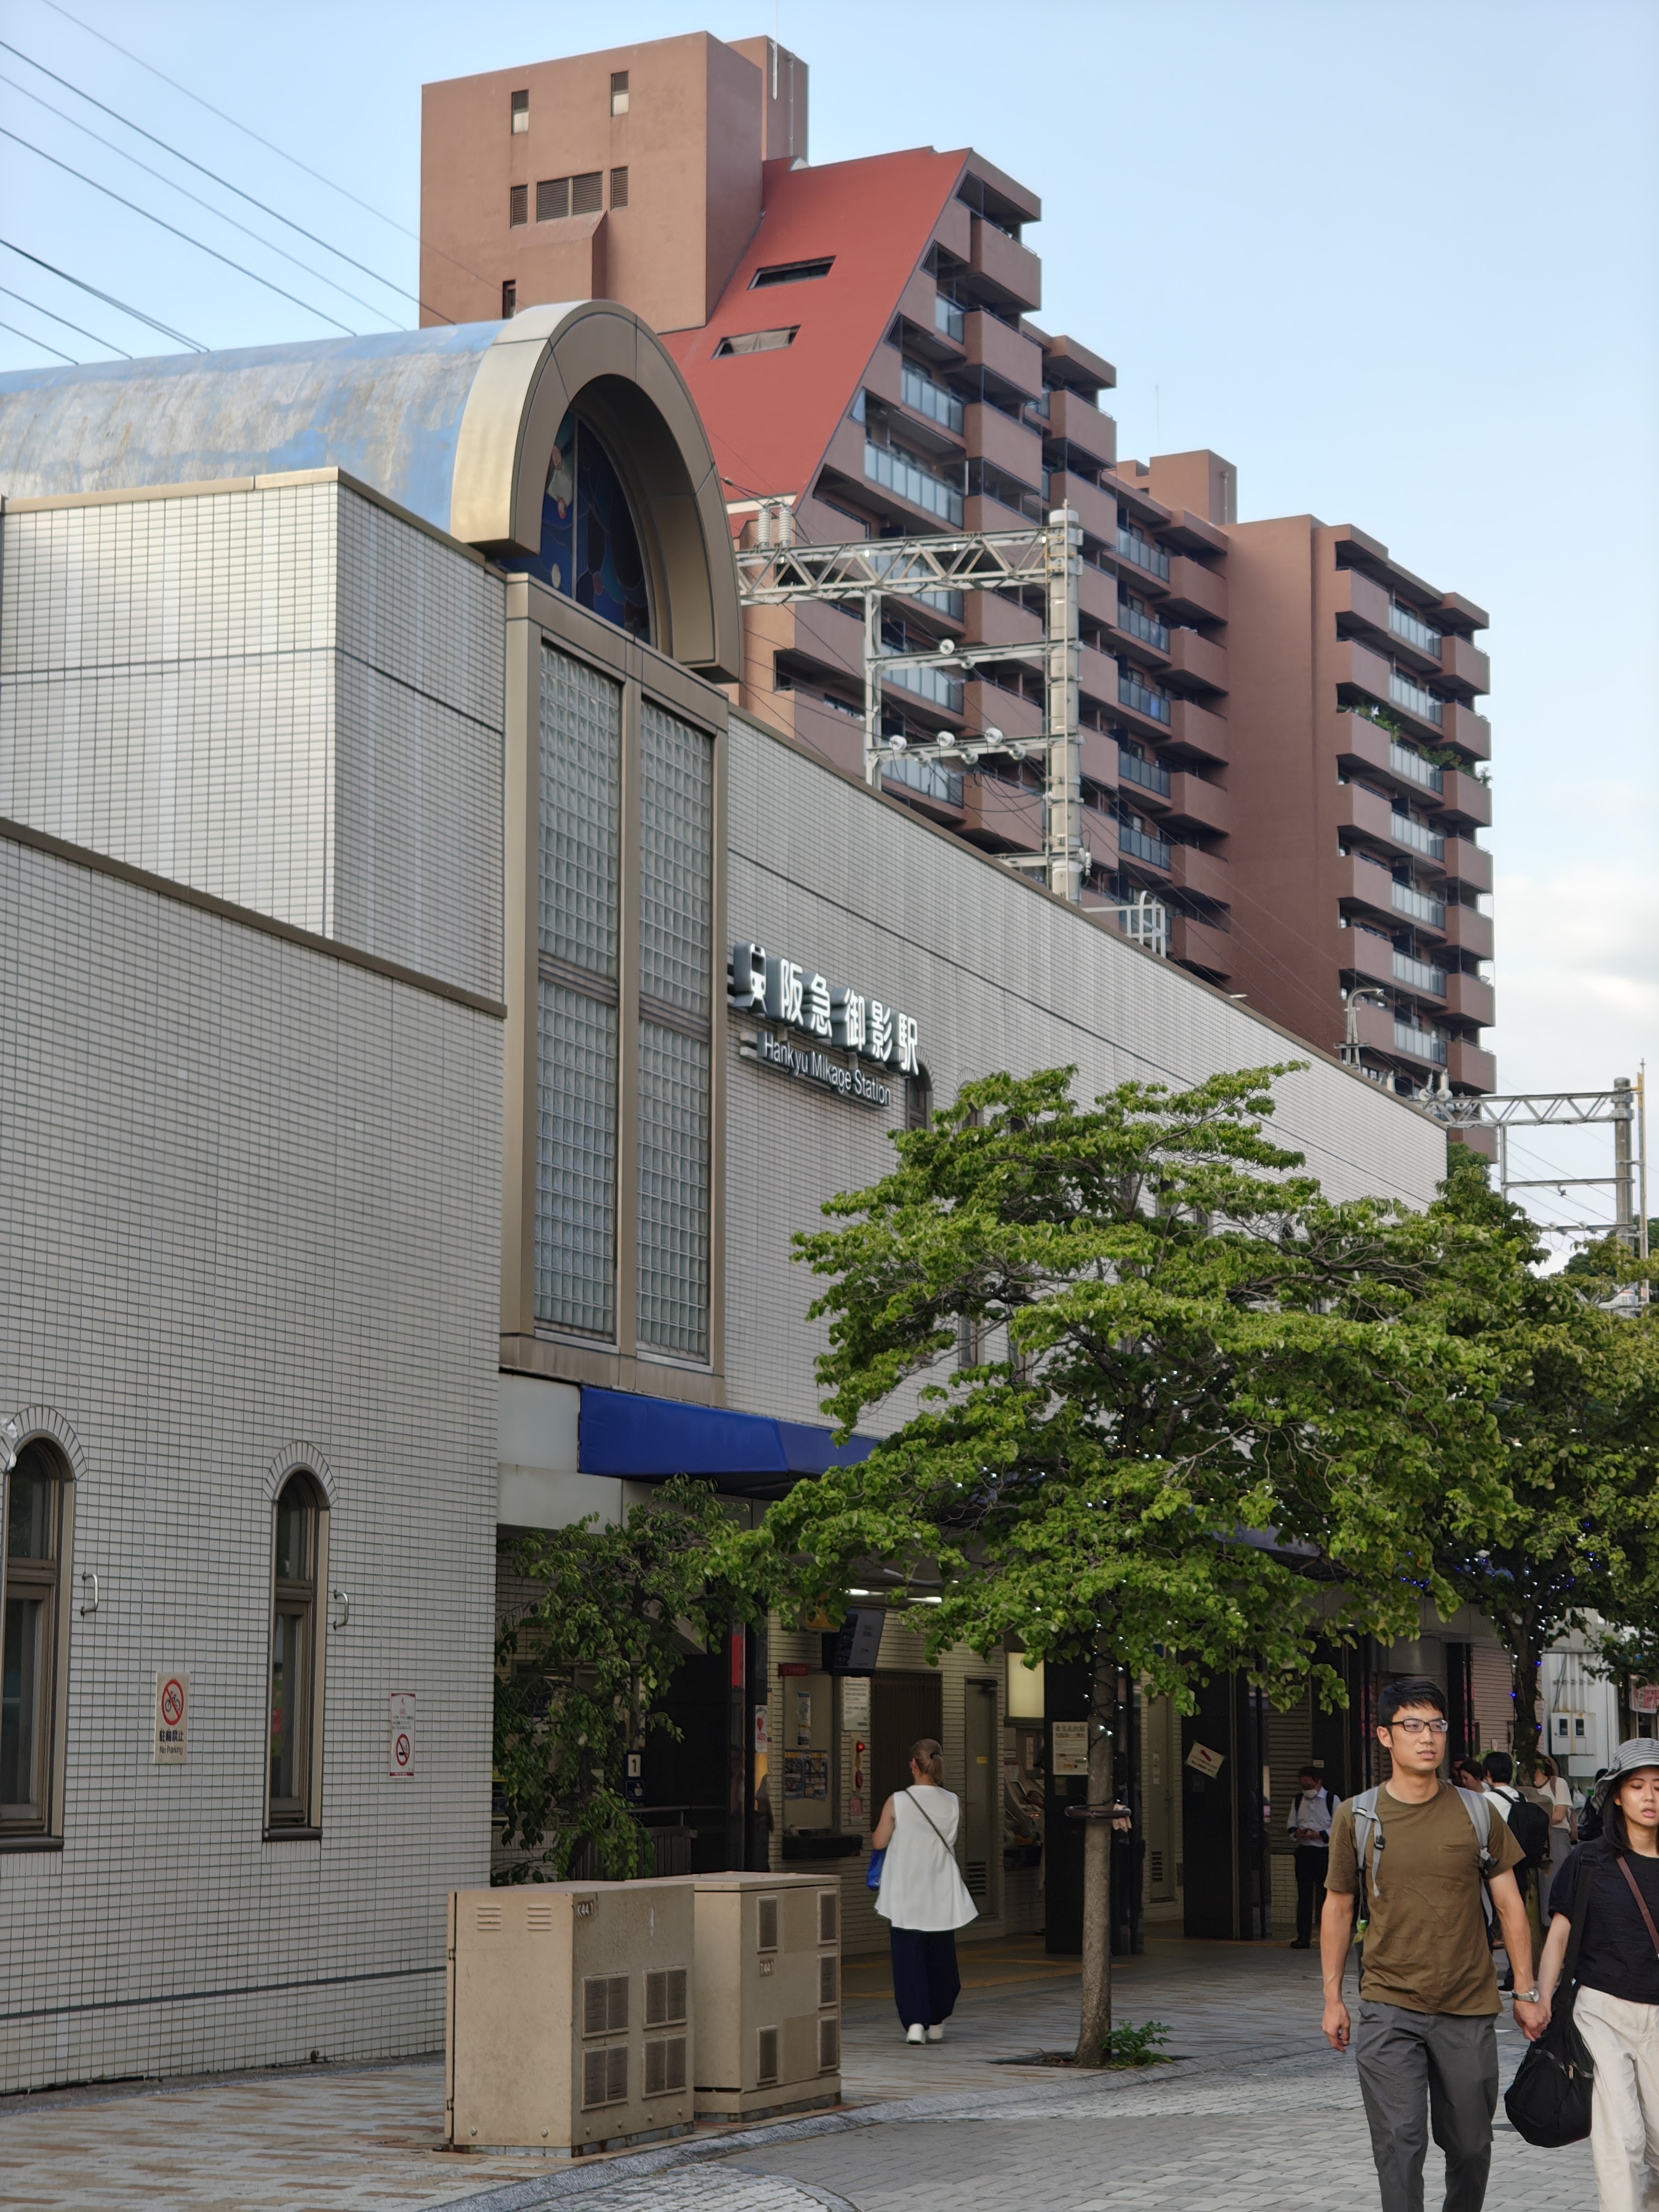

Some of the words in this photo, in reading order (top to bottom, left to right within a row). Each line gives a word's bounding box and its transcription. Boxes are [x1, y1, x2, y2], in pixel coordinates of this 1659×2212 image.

[779, 958, 919, 1076] 阪急御影駅
[764, 1031, 808, 1076] Hankyu
[812, 1051, 852, 1094] Mikage
[855, 1069, 891, 1105] Station
[159, 1729, 184, 1742] 駐輪禁止
[632, 1758, 637, 1773] 1
